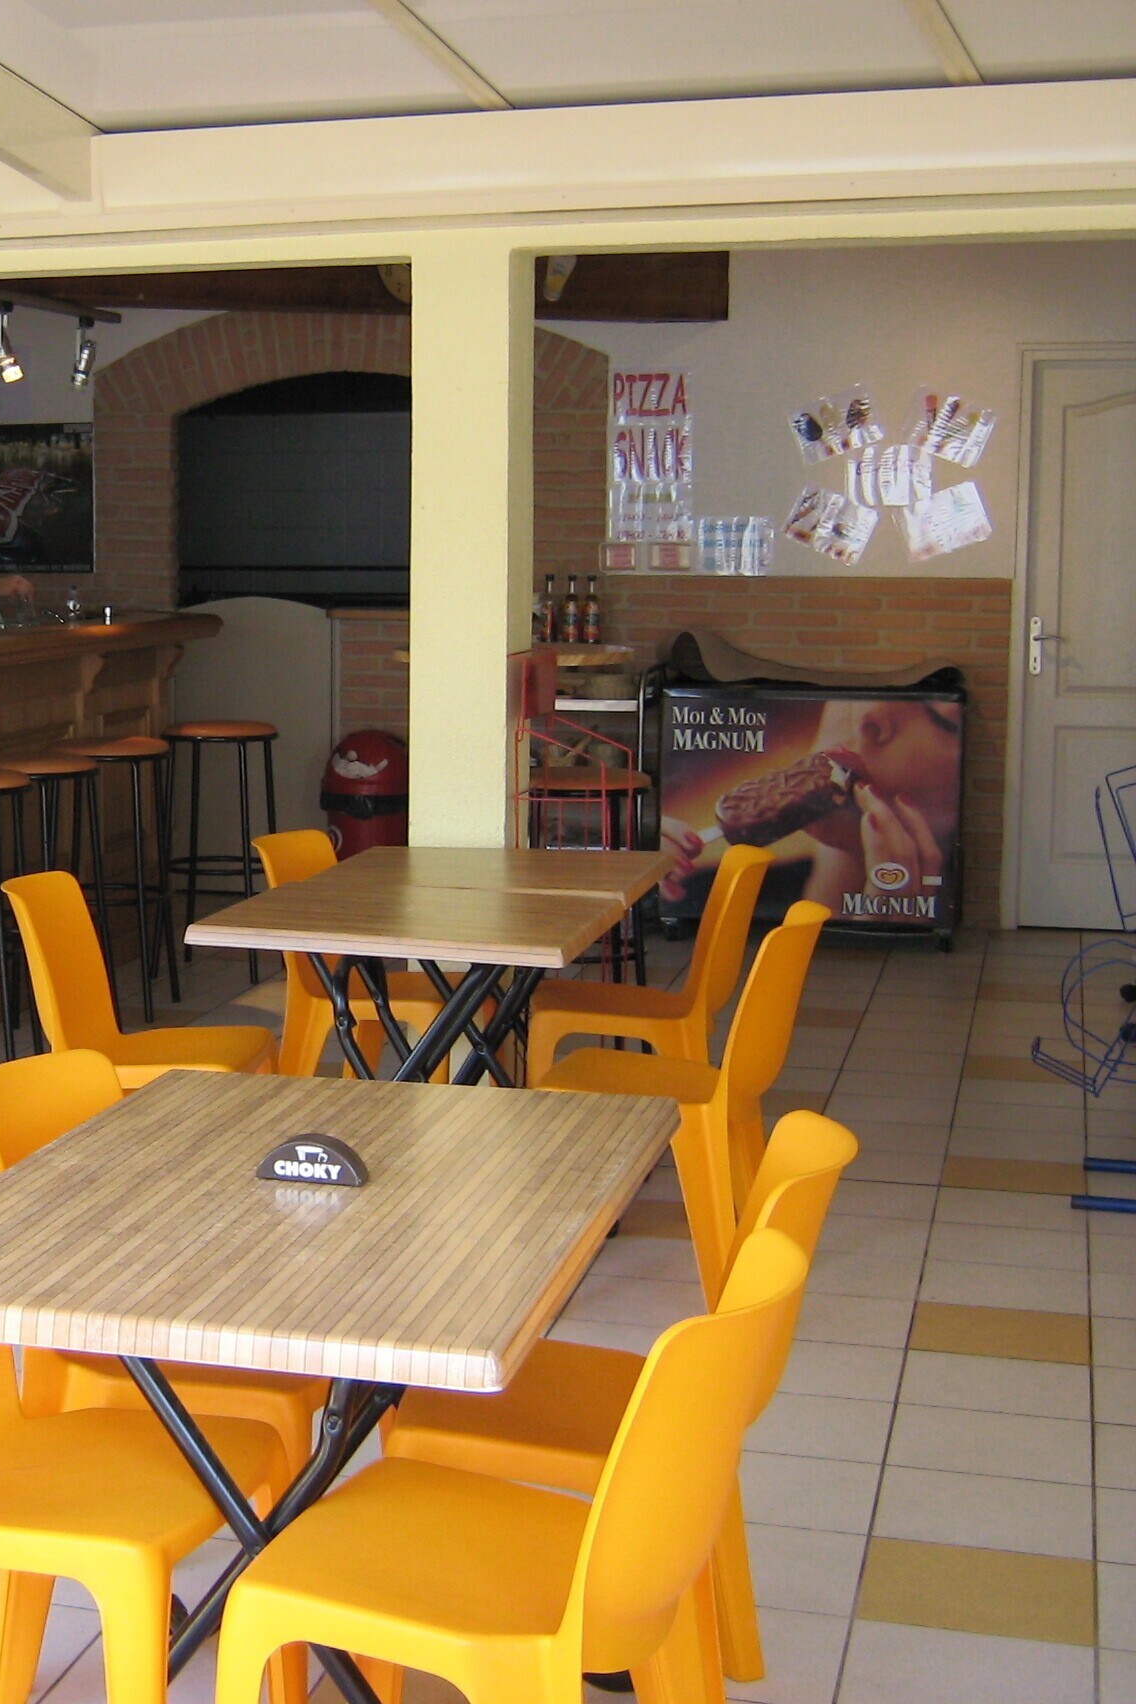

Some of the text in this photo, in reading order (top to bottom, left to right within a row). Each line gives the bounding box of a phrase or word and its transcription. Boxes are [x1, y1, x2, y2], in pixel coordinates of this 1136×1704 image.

[614, 373, 688, 416] PIZZA
[709, 706, 724, 724] &
[672, 728, 765, 753] MAGNUM
[842, 892, 936, 918] MAGNUM
[274, 1160, 342, 1180] CHOKY
